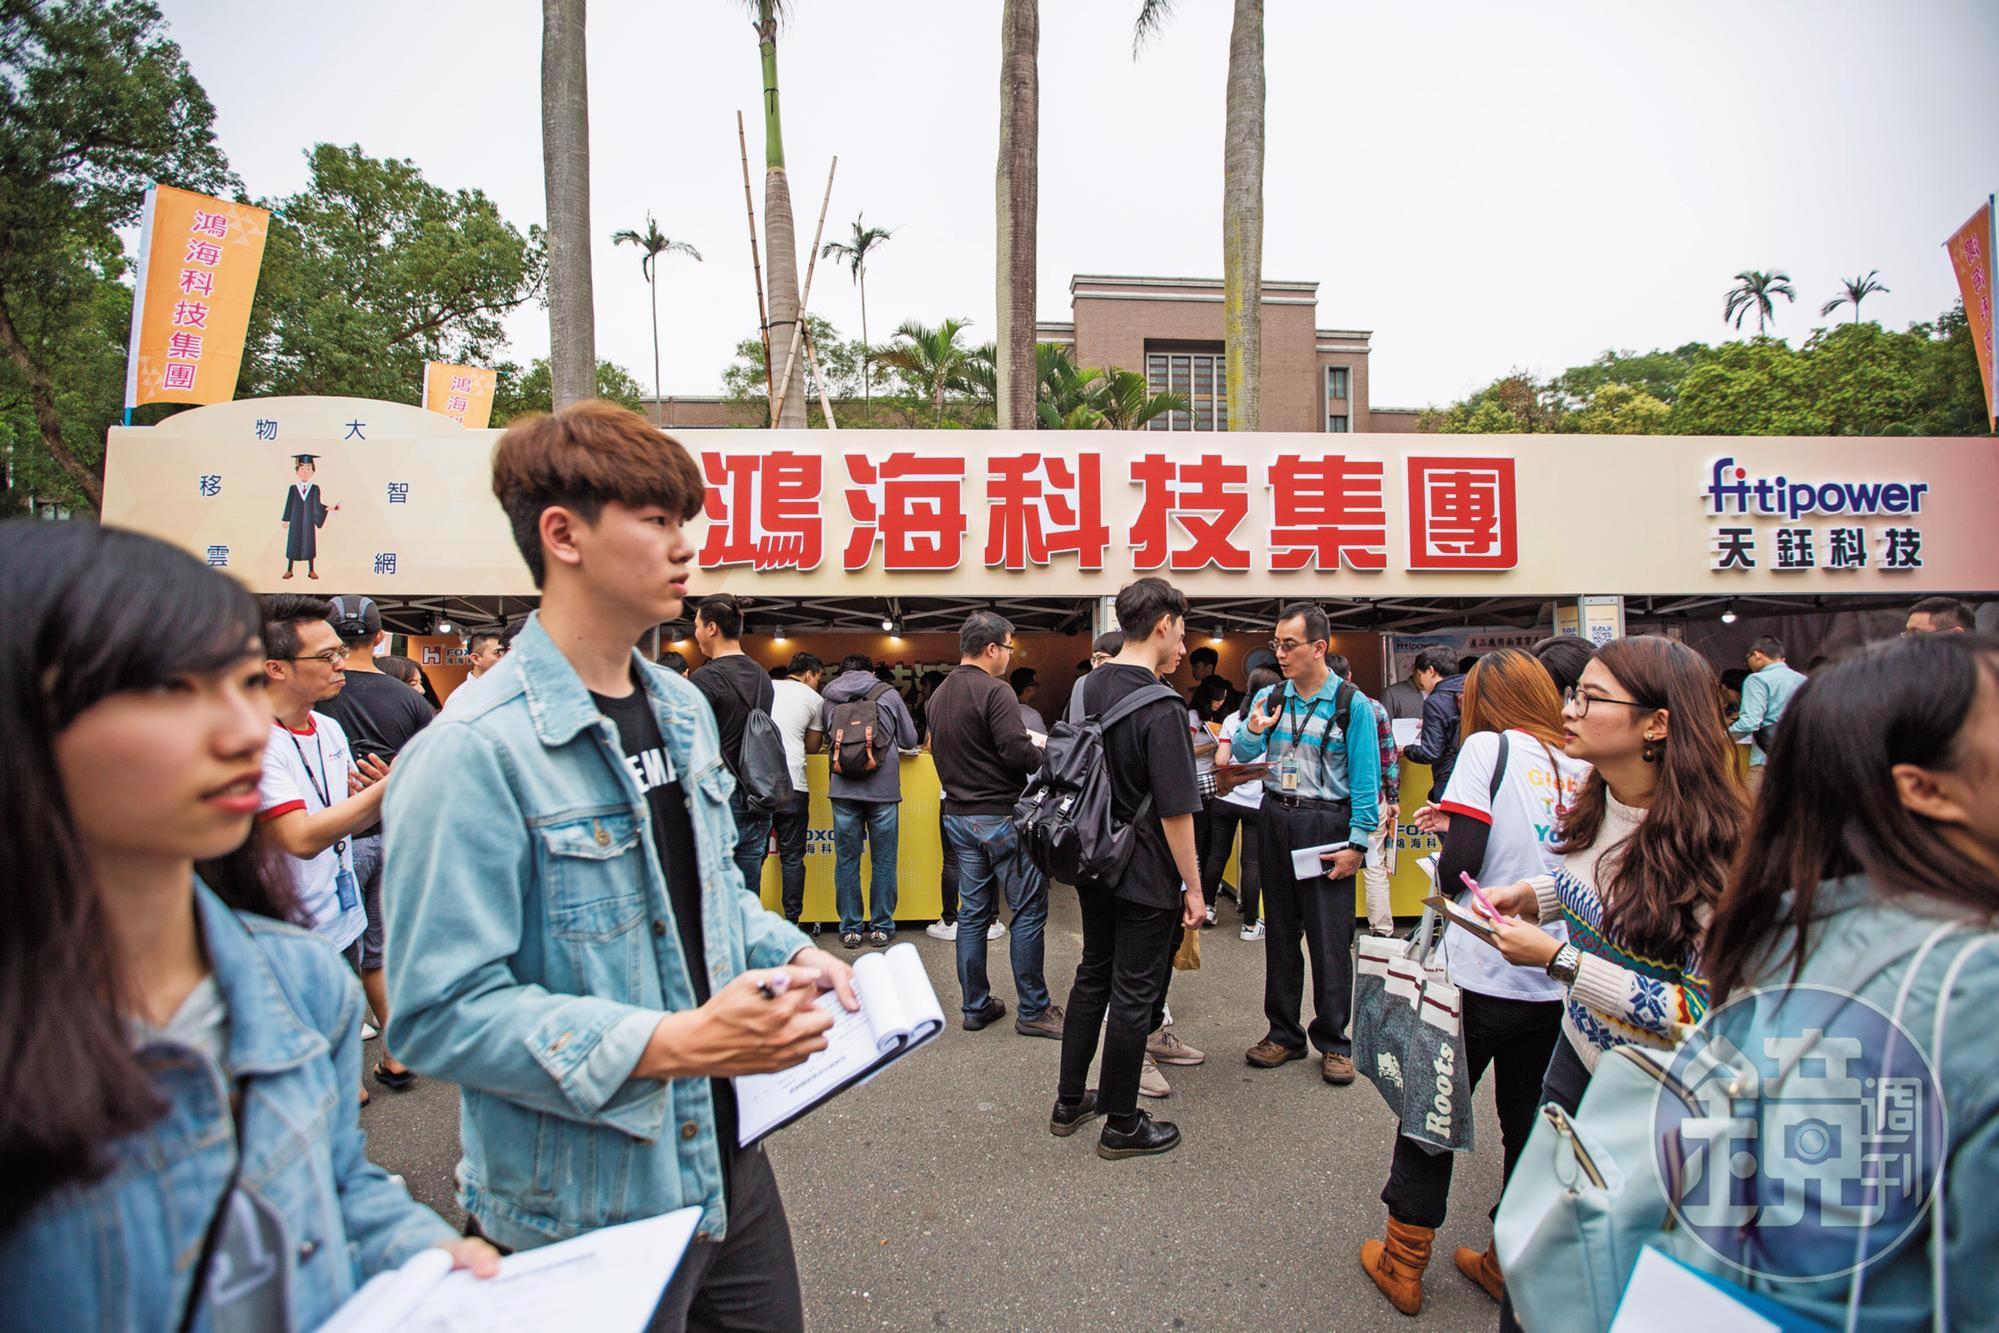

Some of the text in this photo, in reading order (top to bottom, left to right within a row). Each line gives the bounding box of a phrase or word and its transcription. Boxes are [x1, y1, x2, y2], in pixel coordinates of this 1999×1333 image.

[163, 210, 229, 390] 鴻海科技集團
[255, 418, 278, 441] 物
[344, 418, 367, 441] 大
[199, 474, 222, 497] 移
[387, 481, 409, 504] 智
[1708, 457, 1928, 520] fitipower
[697, 450, 1519, 571] 鴻海科技集團
[207, 545, 230, 567] 雲
[1718, 528, 1923, 567] 天鈺科技
[373, 552, 397, 575] 網
[1425, 1041, 1455, 1140] Roots
